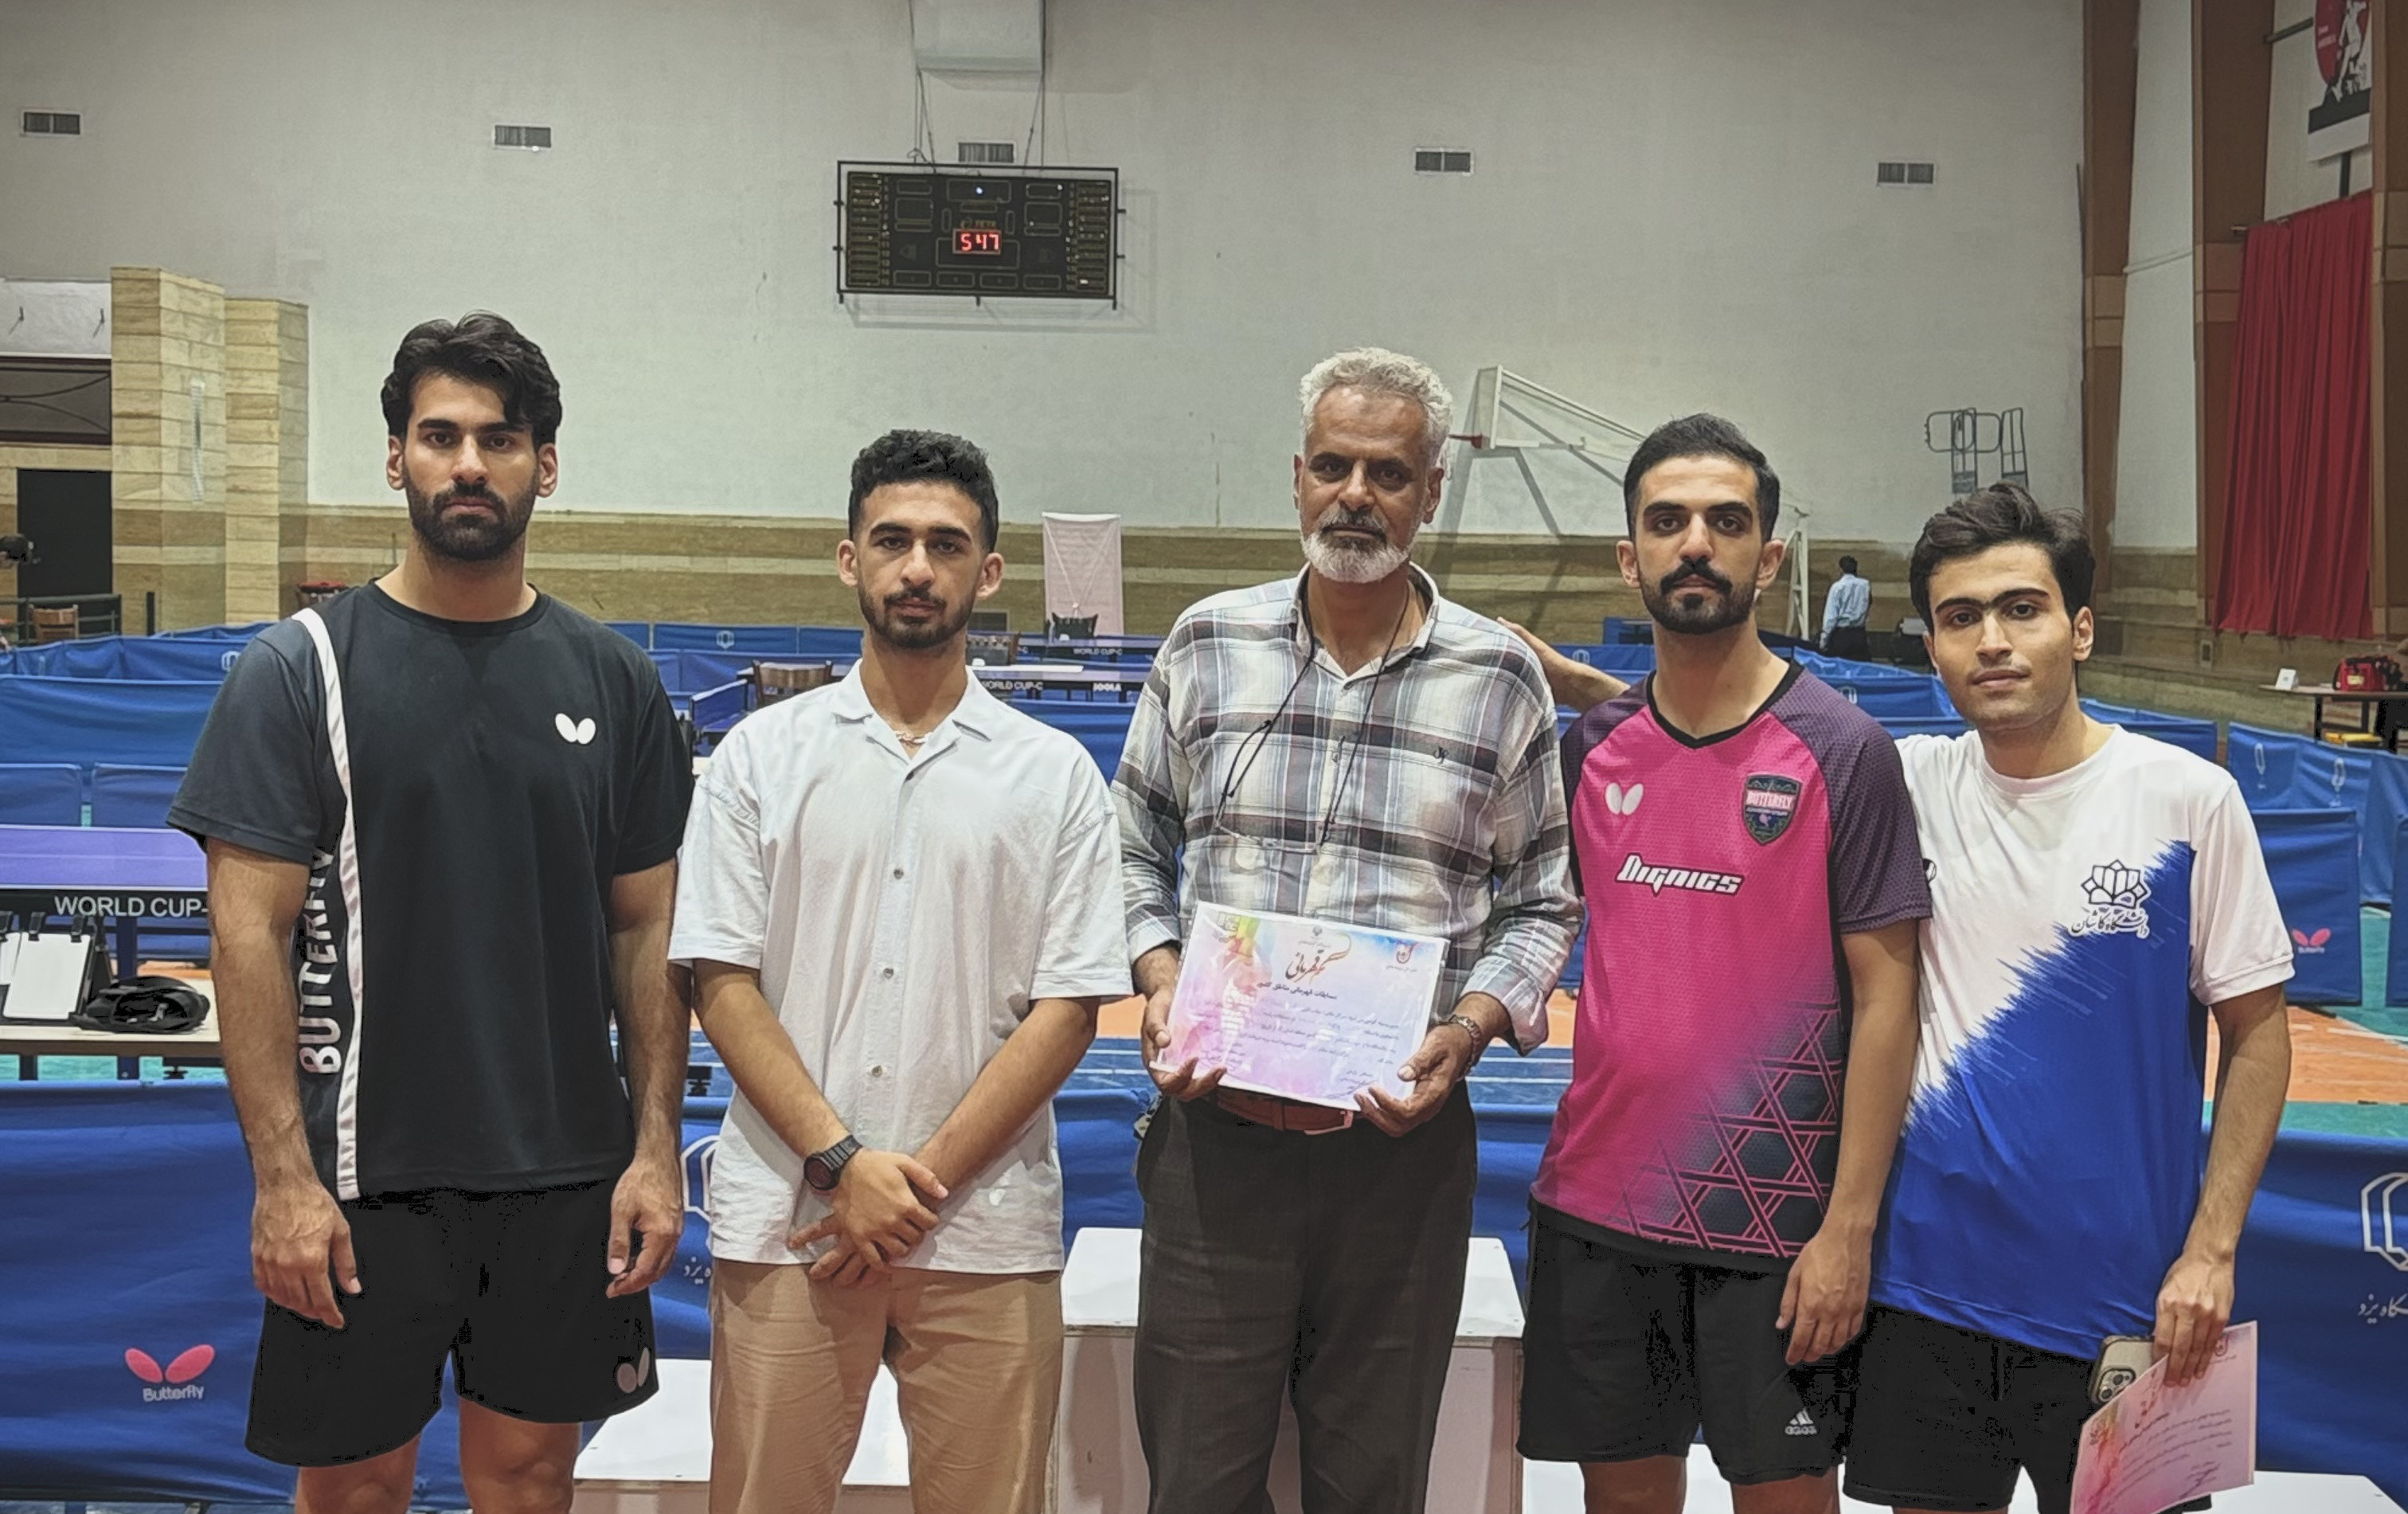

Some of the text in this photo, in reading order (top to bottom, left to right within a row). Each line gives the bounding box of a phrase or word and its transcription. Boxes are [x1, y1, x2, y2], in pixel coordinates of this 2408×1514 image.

[1093, 682, 1121, 692] JOOLA
[54, 896, 145, 917] WORLD
[143, 1384, 205, 1403] Butterfly
